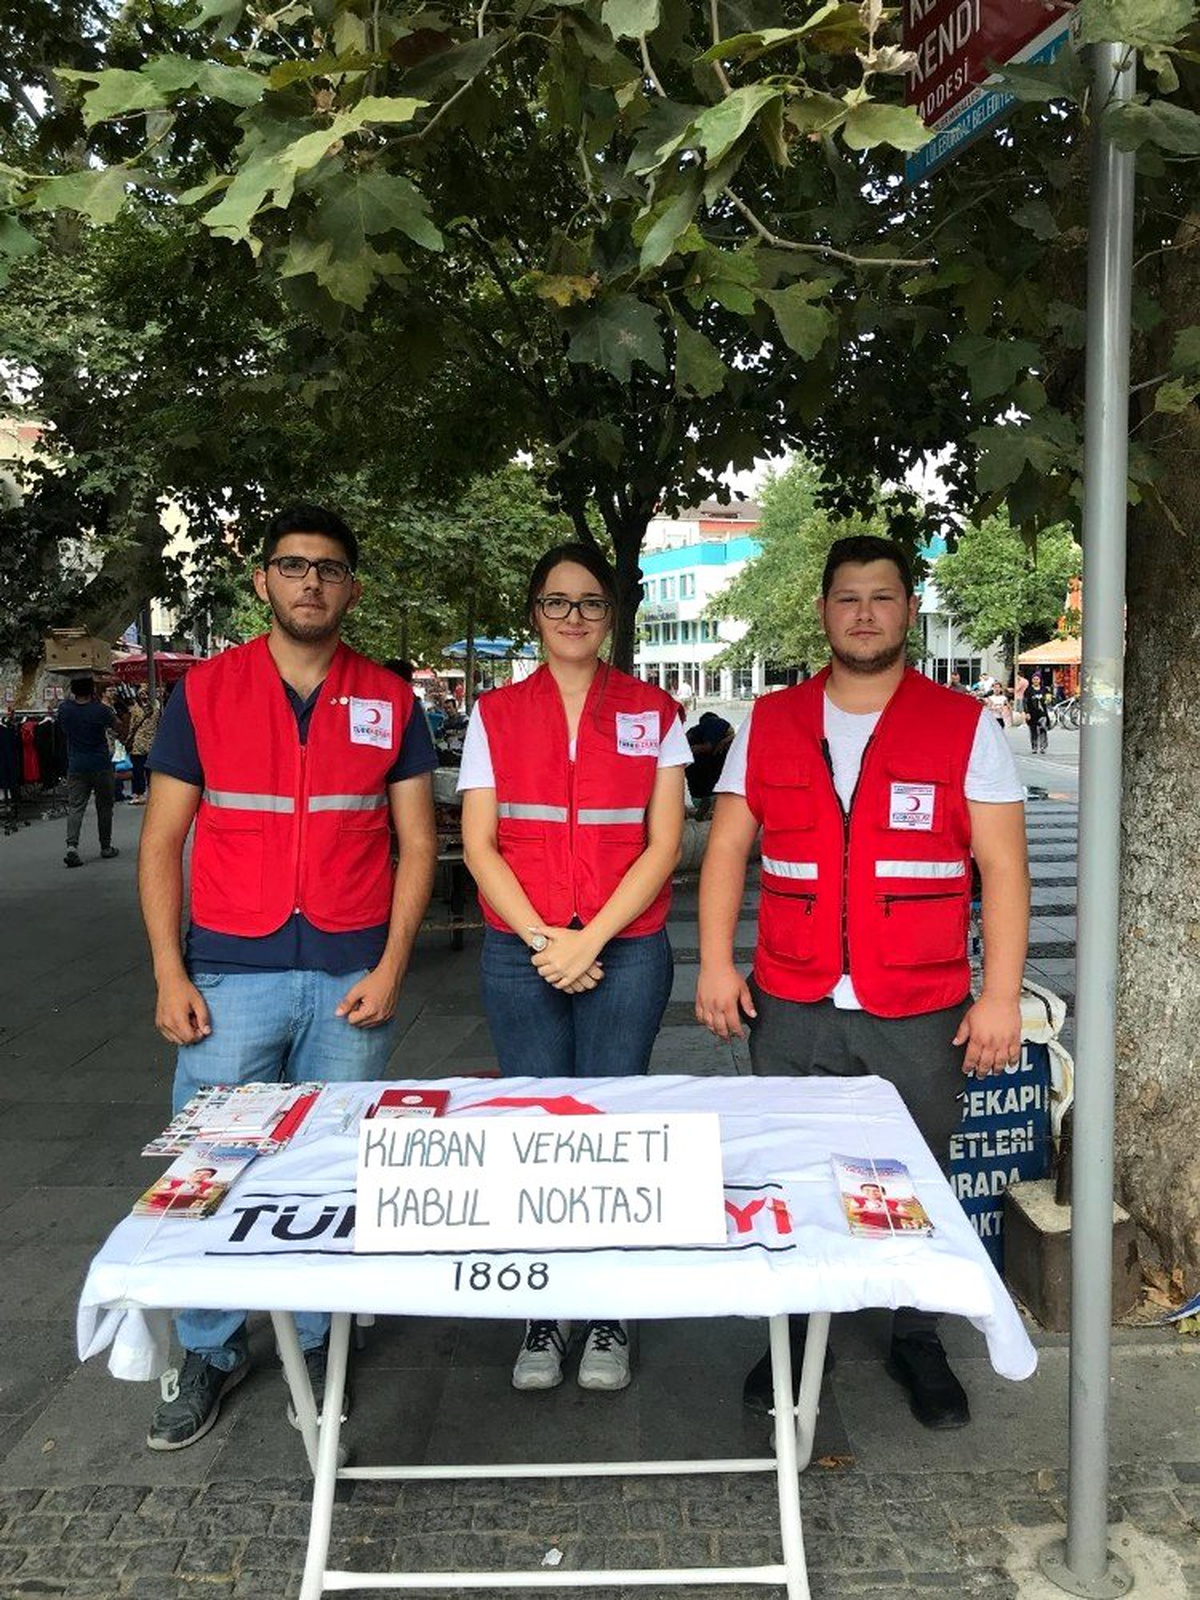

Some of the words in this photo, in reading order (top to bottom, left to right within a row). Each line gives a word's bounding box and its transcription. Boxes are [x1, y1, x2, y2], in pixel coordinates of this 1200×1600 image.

[917, 56, 969, 119] ADDESİ
[364, 1127, 486, 1168] KURBAN
[512, 1124, 669, 1164] VEKALETİ
[377, 1186, 490, 1228] KABUL
[518, 1185, 662, 1225] NOKTASI
[452, 1260, 550, 1292] 1868
